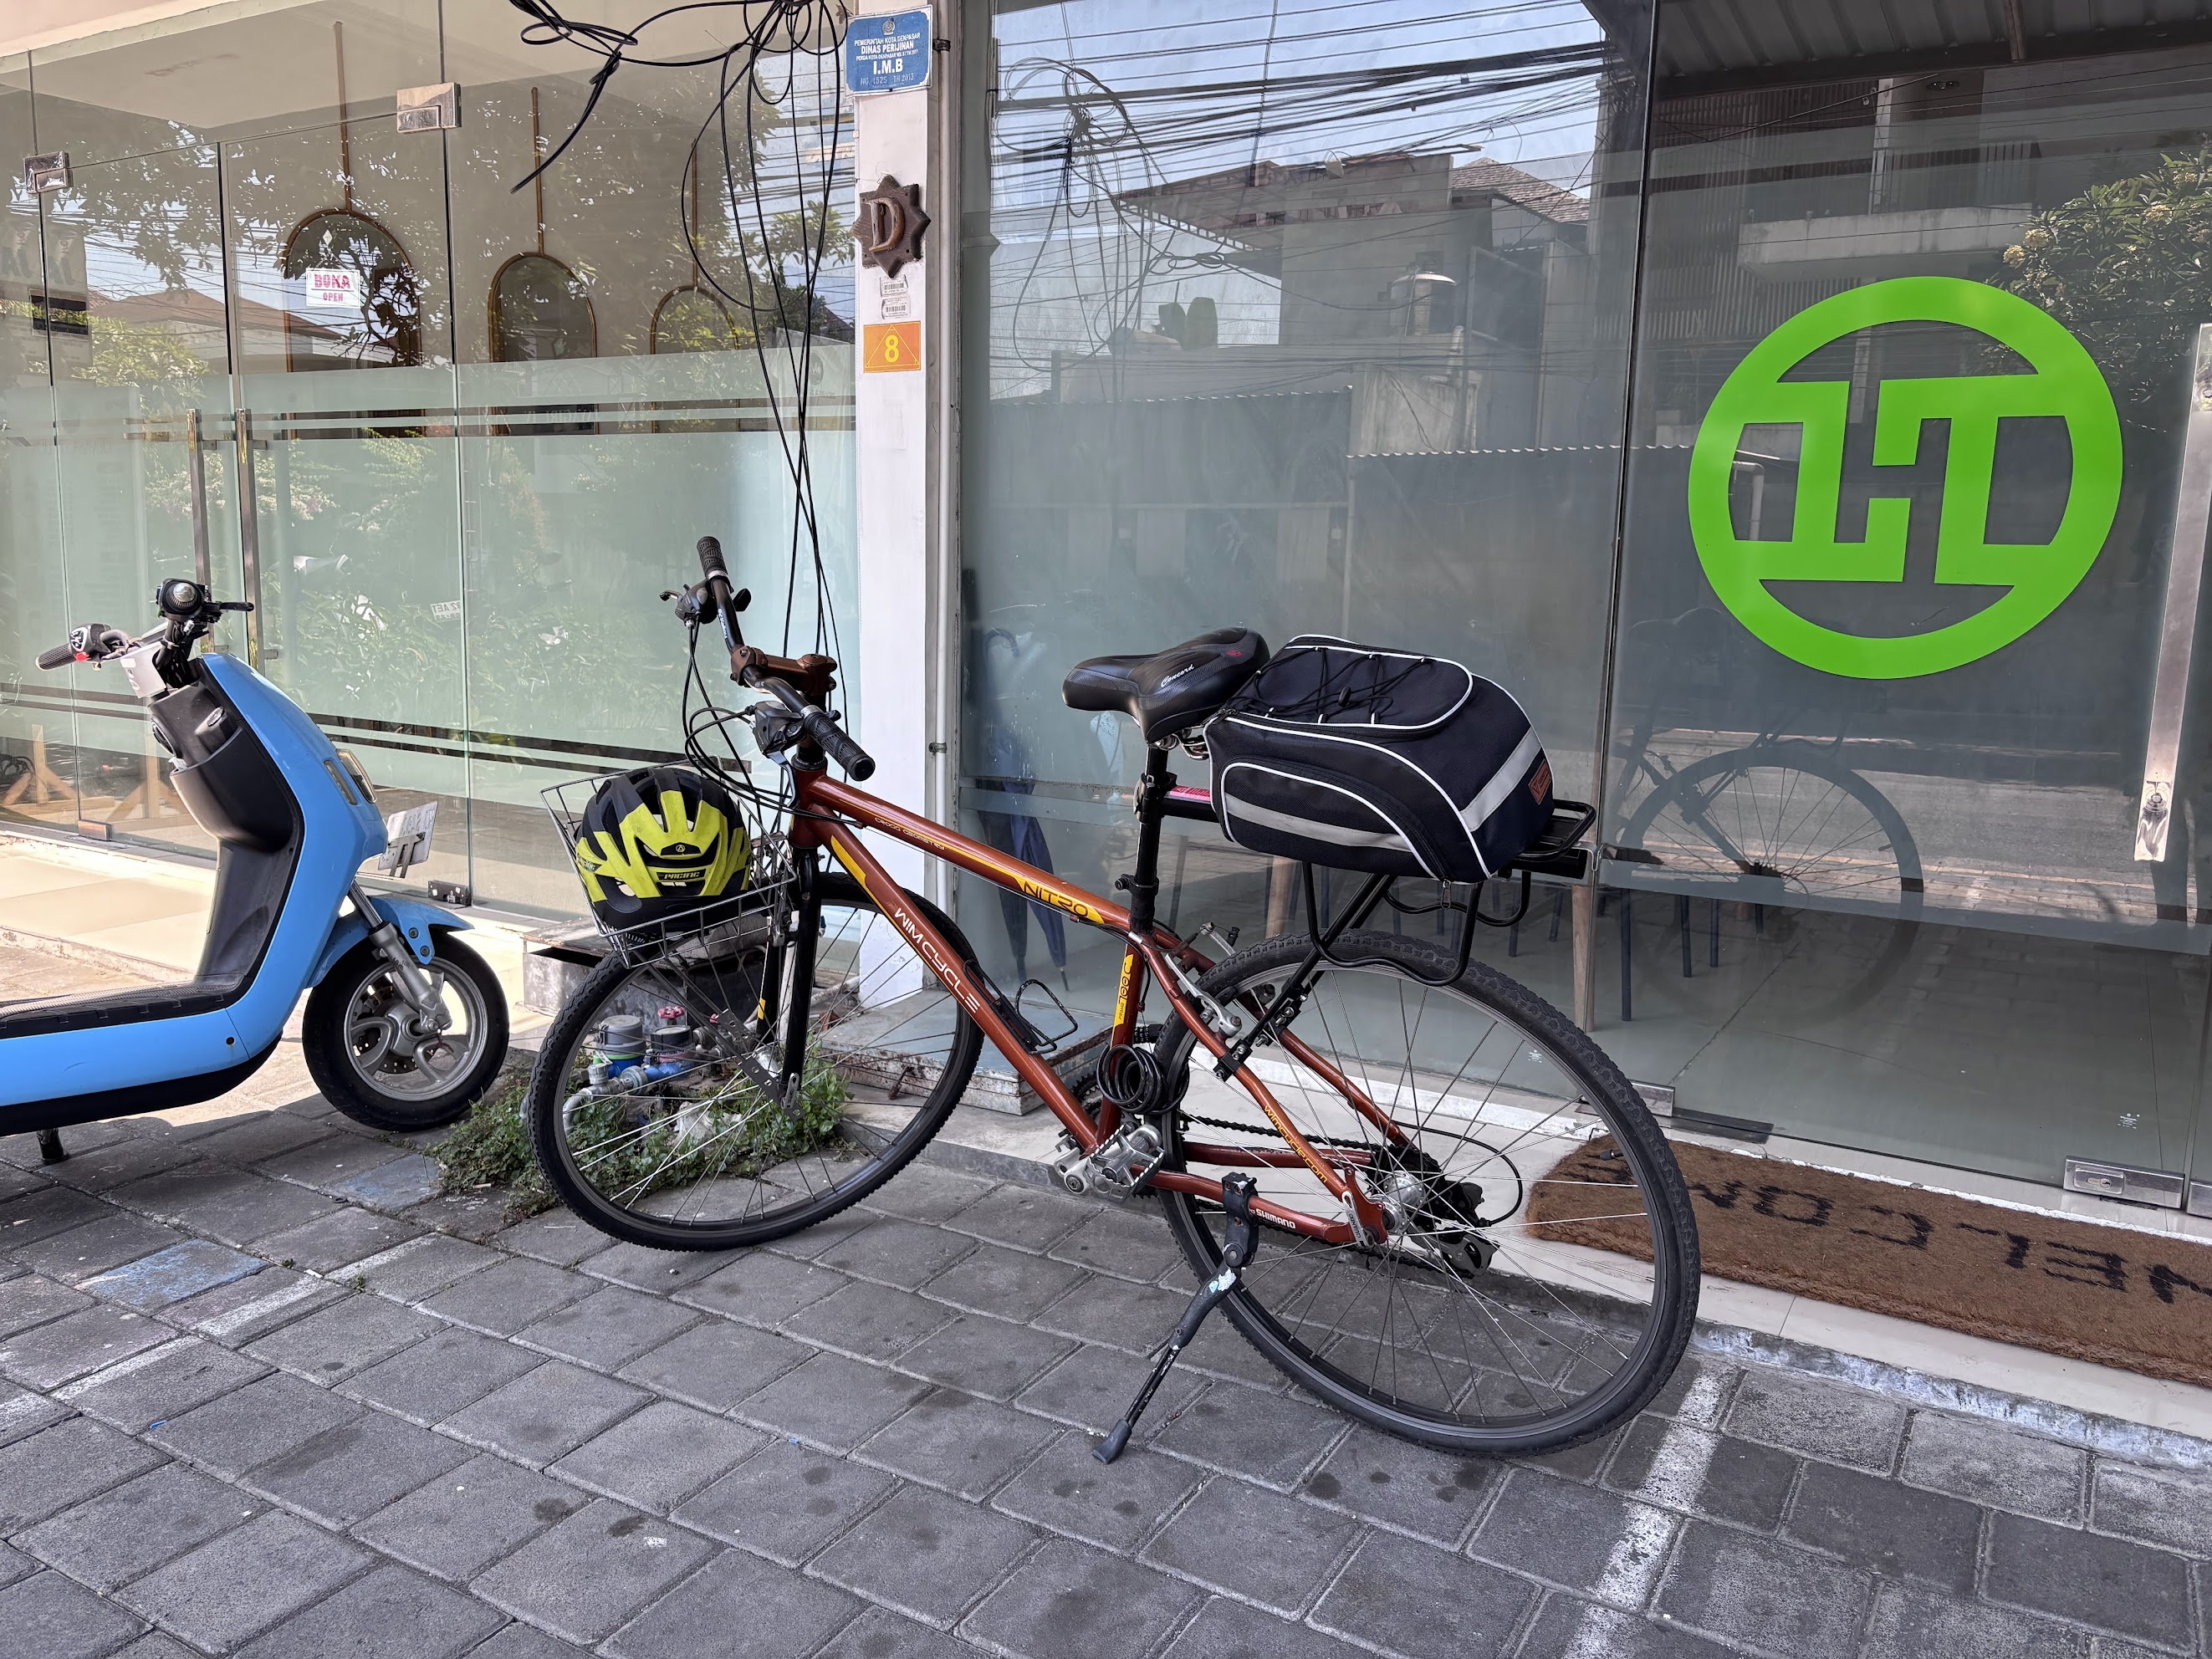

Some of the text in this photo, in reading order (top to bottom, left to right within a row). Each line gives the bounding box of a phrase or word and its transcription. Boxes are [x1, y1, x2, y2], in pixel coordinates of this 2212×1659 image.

[861, 40, 914, 55] DINAS PERIJINAN
[873, 59, 903, 74] I.M.B
[873, 76, 887, 84] 1525
[866, 197, 905, 252] D
[314, 274, 350, 289] BUKA
[323, 293, 344, 301] OPEN
[884, 334, 900, 363] 8
[1161, 664, 1194, 687] Concord
[664, 871, 700, 880] PACIFIC
[1024, 881, 1089, 917] NITRO
[1264, 1105, 1328, 1183] wimcycle.com
[1255, 1208, 1296, 1229] SHIMANO
